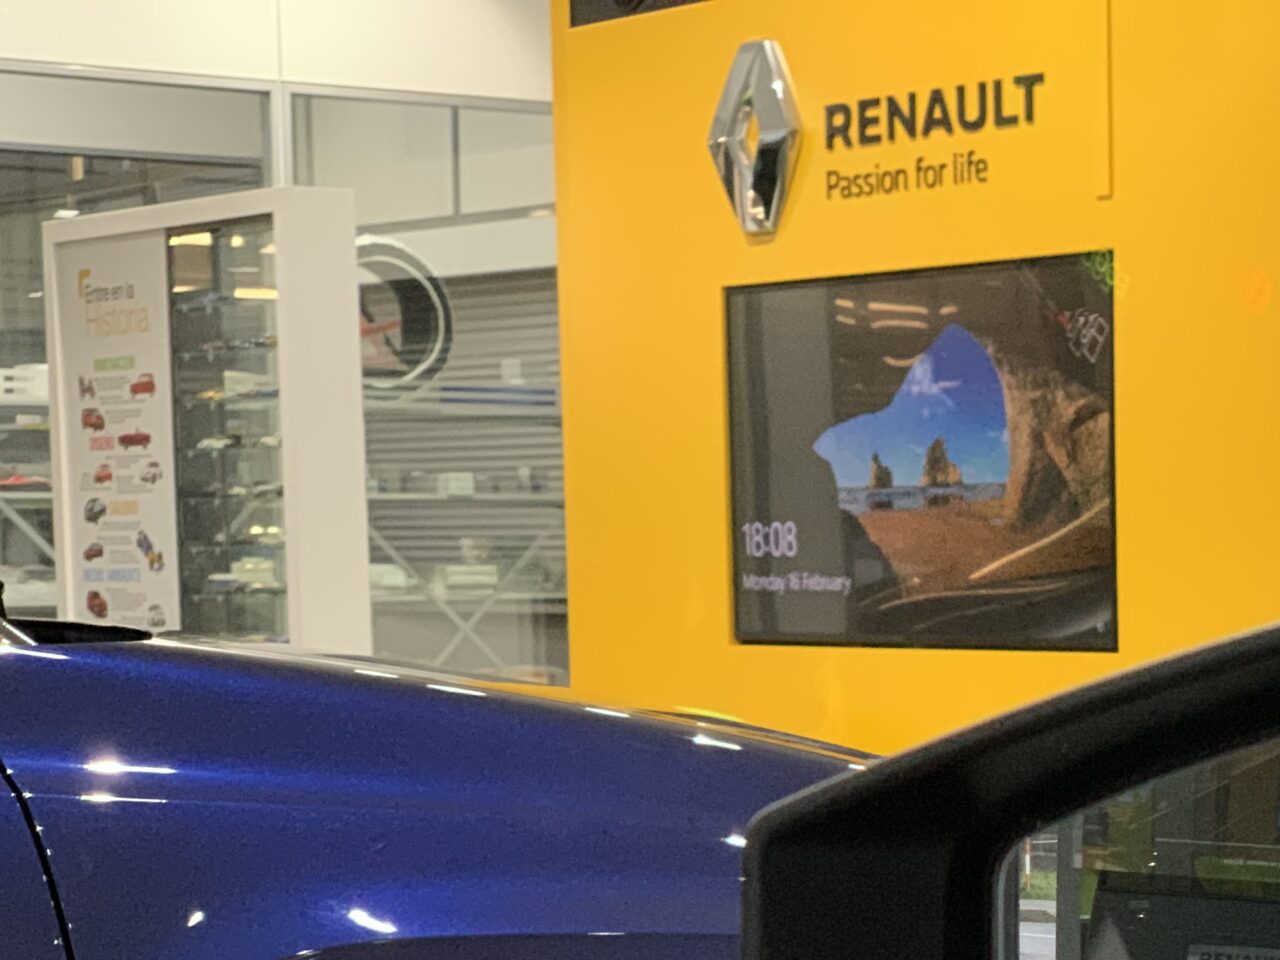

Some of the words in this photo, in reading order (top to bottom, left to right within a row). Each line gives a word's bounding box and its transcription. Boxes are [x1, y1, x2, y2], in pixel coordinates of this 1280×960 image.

[825, 72, 1045, 151] RENAULT
[826, 164, 909, 200] Passion
[915, 157, 948, 189] for
[952, 150, 989, 185] life
[742, 520, 798, 557] 18:08
